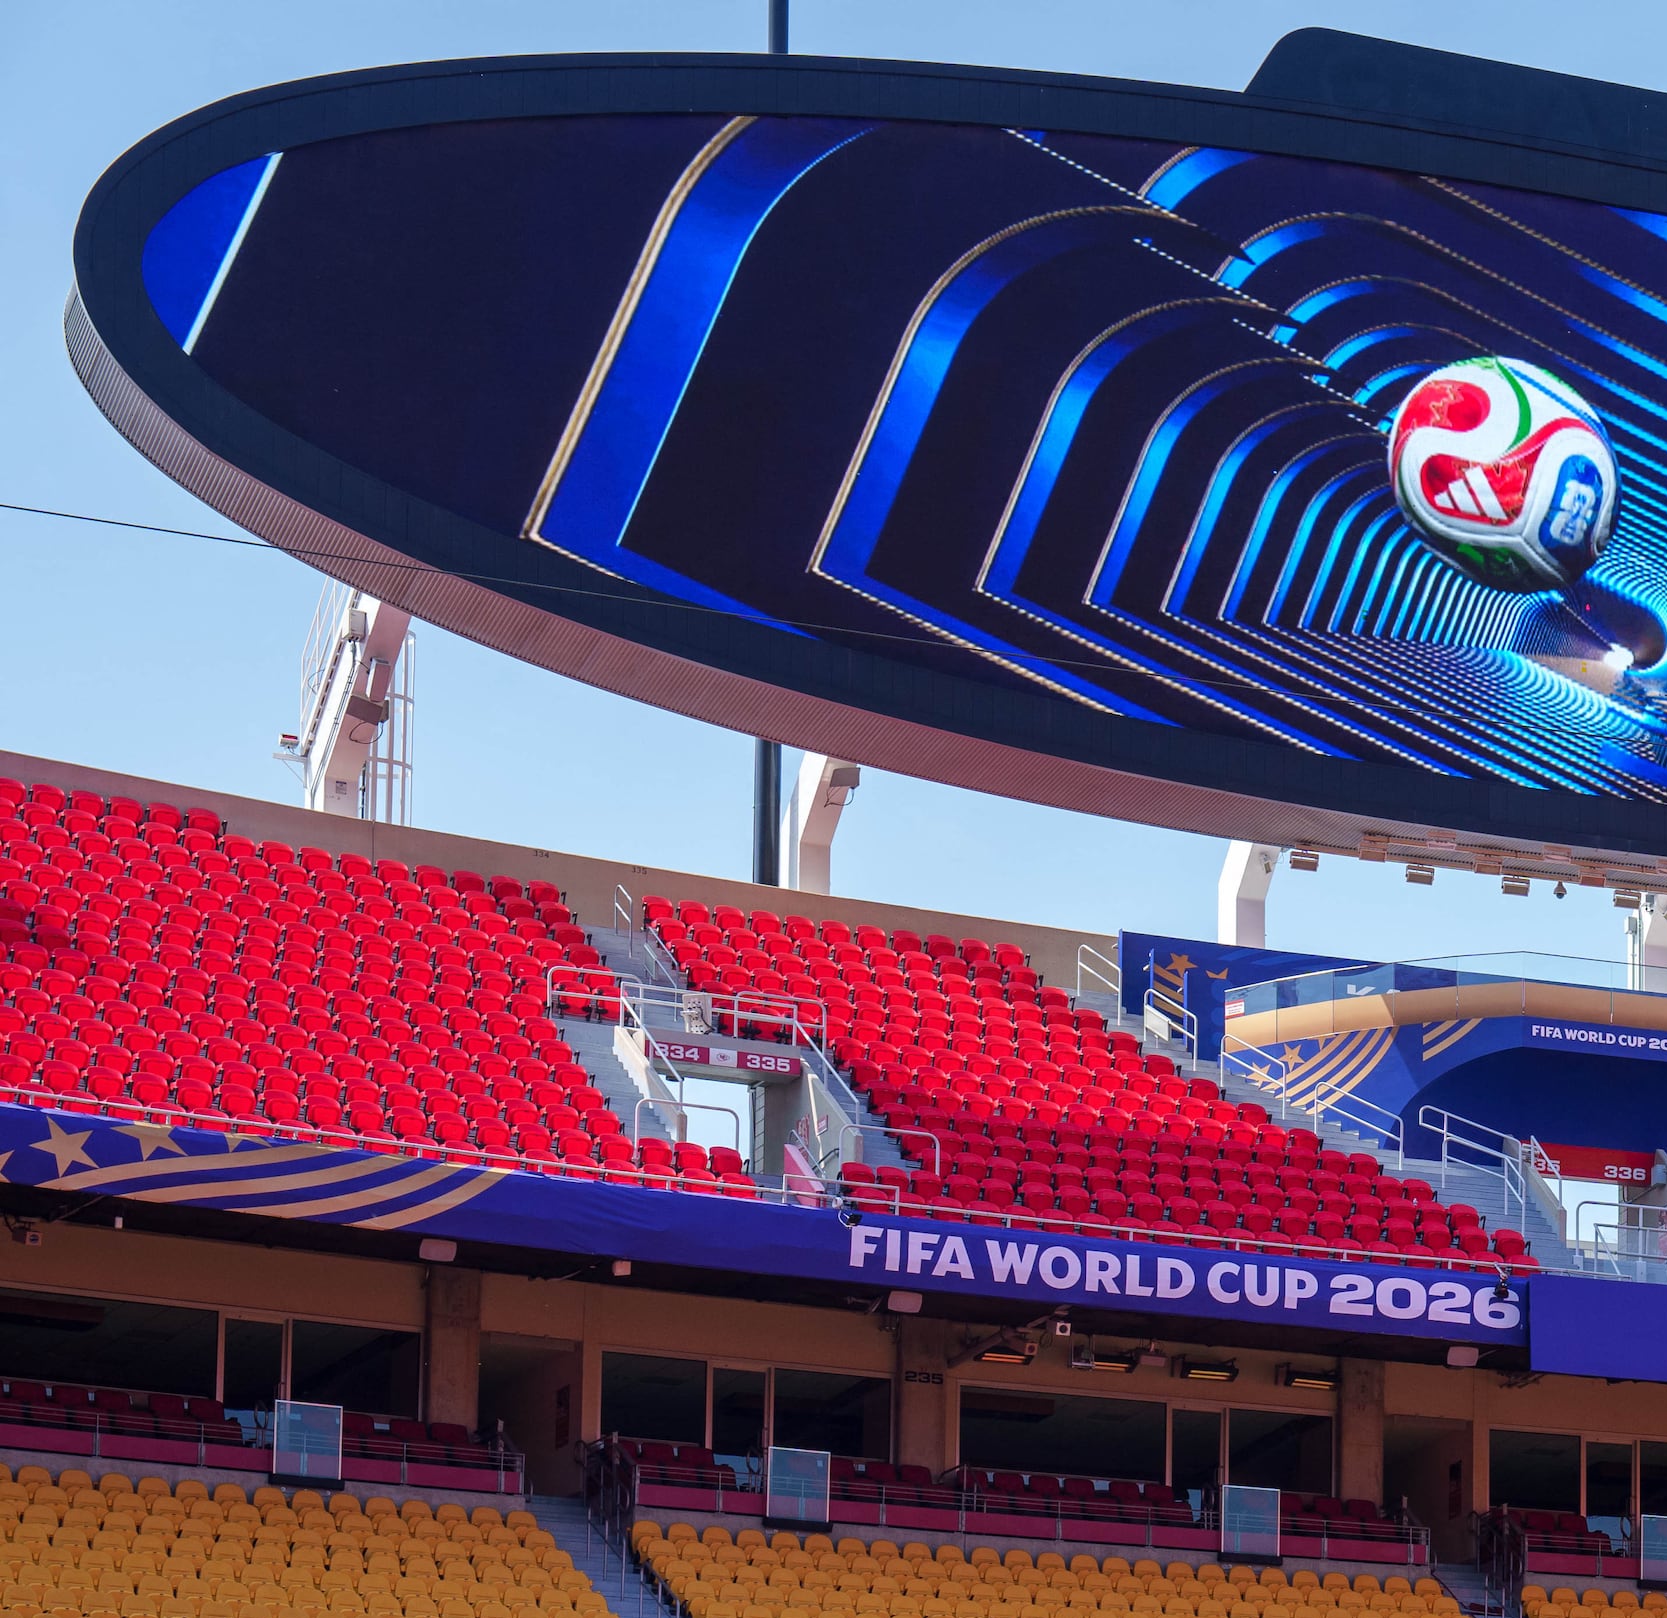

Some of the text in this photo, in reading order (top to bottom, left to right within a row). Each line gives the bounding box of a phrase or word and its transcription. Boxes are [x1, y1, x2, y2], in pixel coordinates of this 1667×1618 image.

[1531, 1024, 1563, 1040] FIFA
[1564, 1027, 1616, 1045] WORLD
[1618, 1034, 1647, 1048] CUP
[654, 1042, 700, 1062] 334
[746, 1054, 791, 1073] 335
[1534, 1158, 1561, 1173] 35
[1603, 1164, 1646, 1181] 336
[848, 1224, 1522, 1330] FIFA WORLD CUP 2026
[905, 1370, 944, 1385] 235
